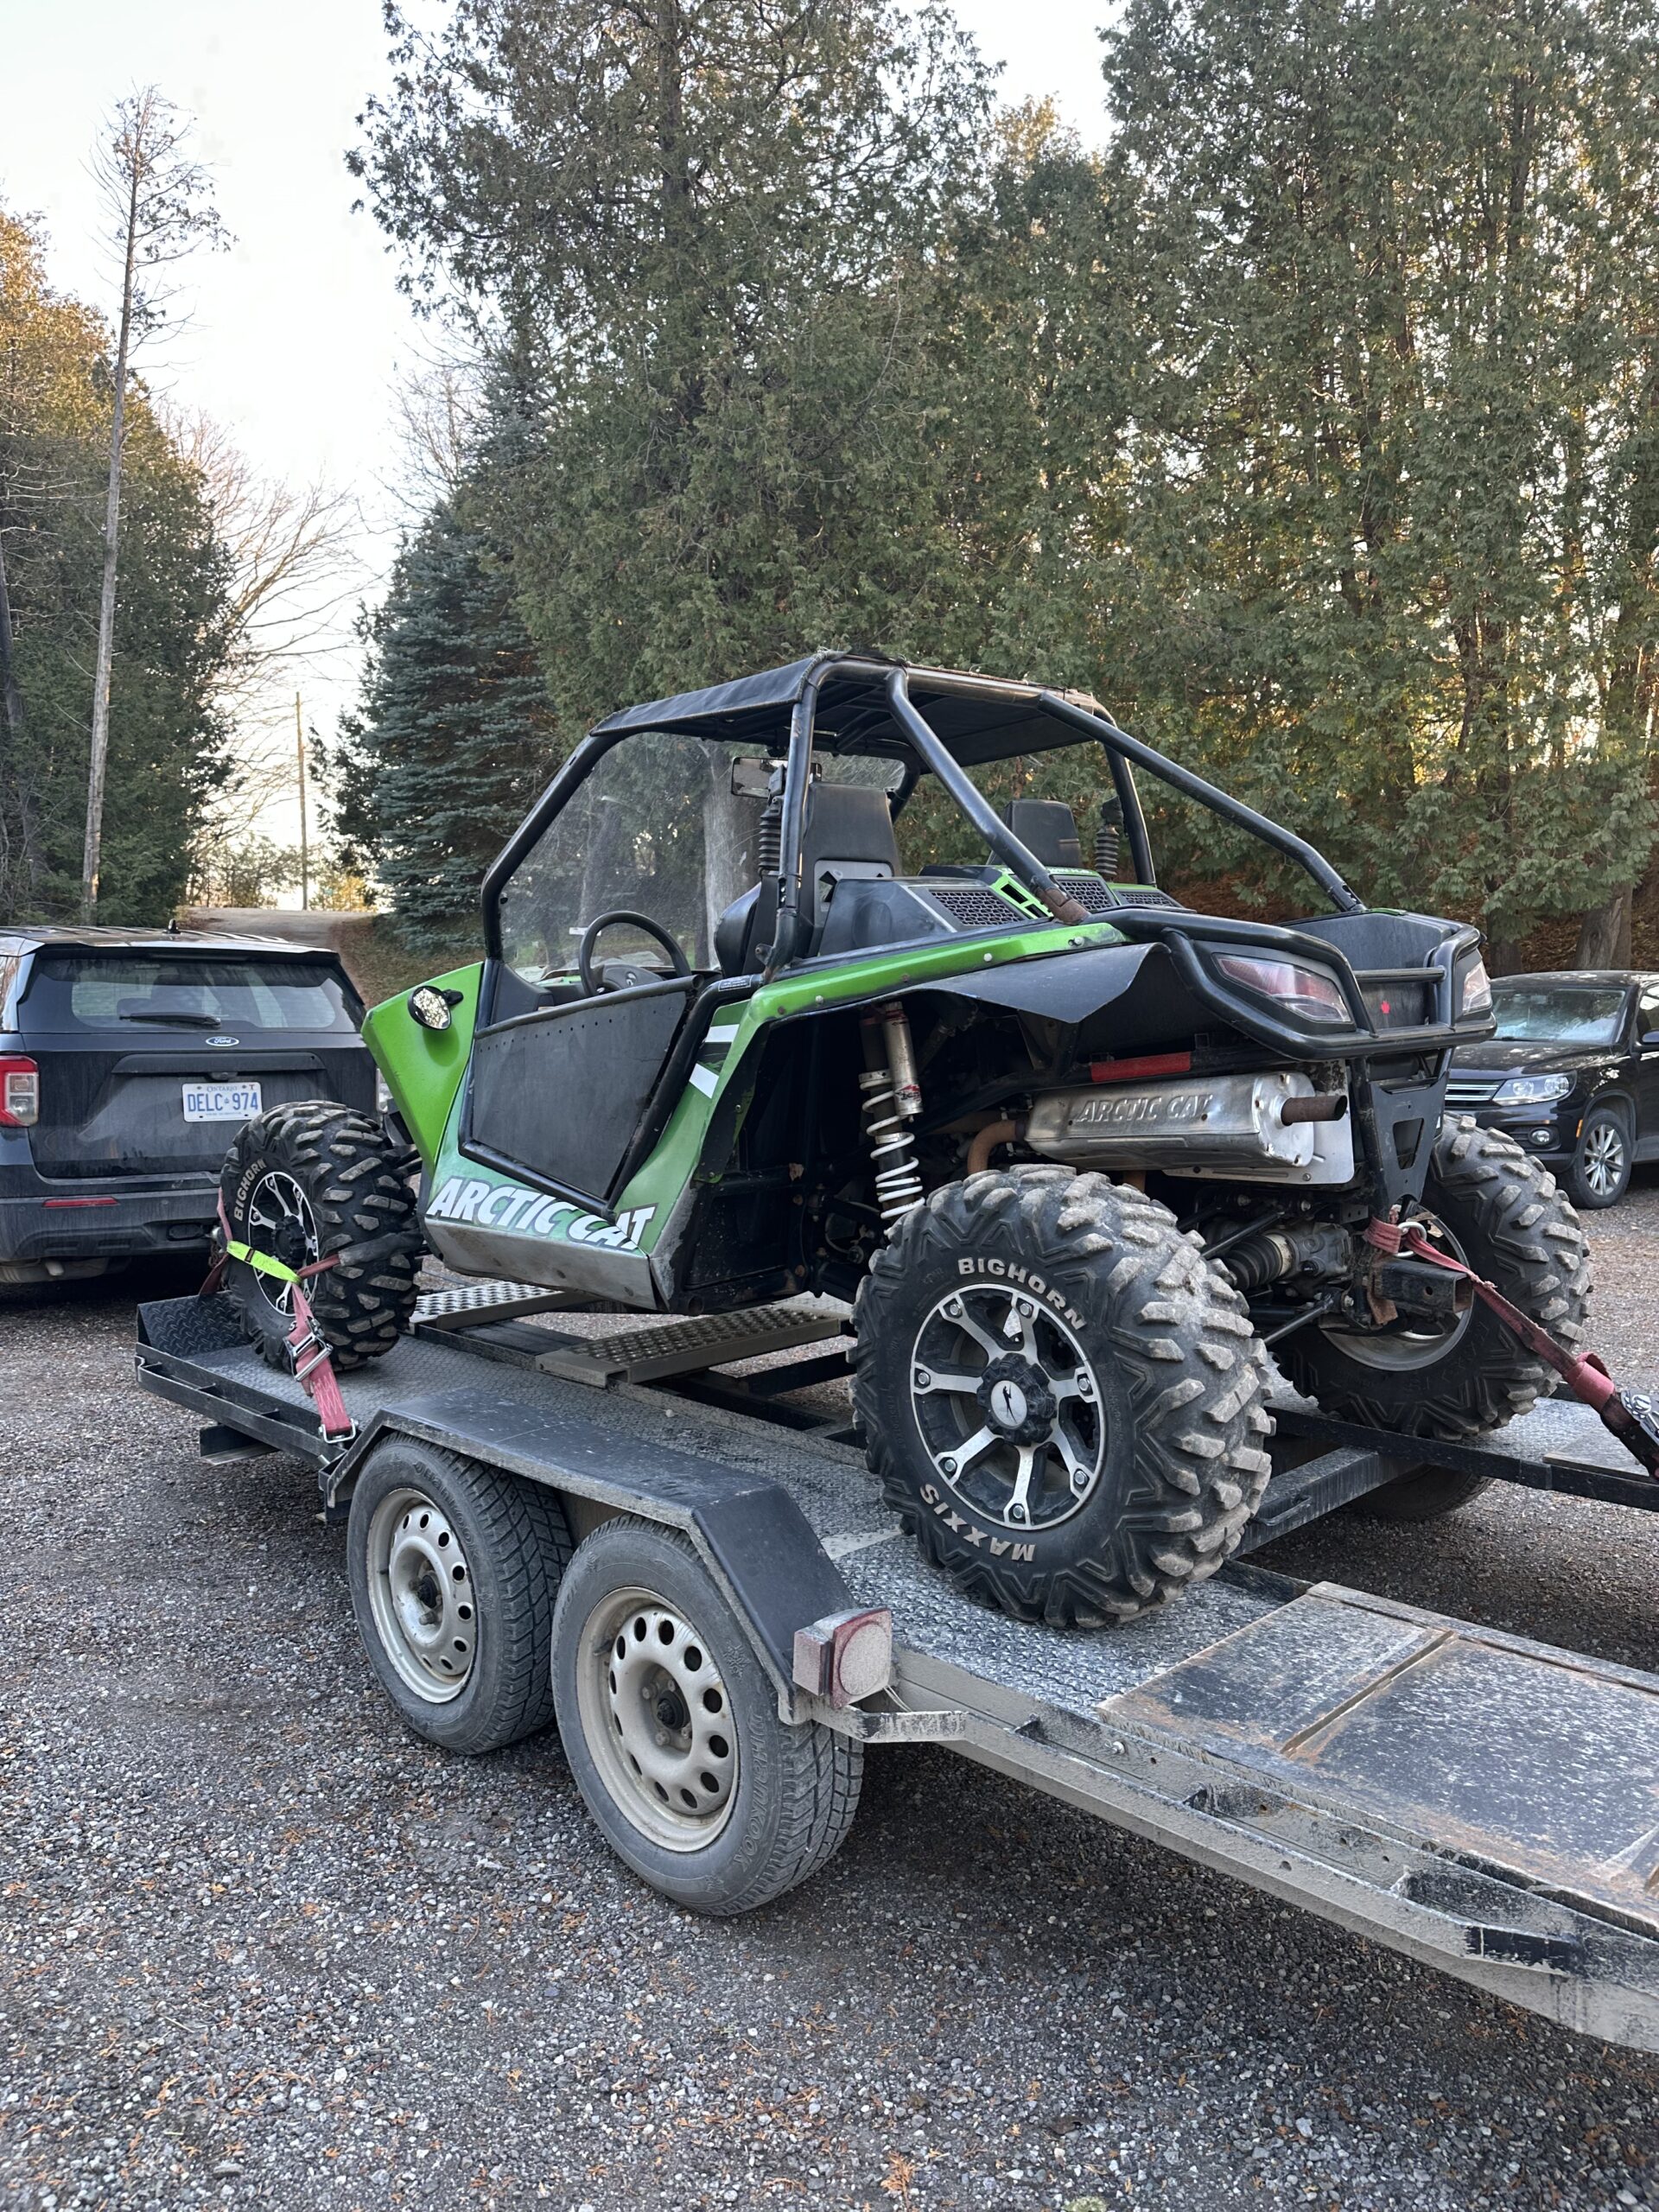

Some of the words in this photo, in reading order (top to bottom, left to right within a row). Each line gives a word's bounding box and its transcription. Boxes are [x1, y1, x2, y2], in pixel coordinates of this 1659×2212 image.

[188, 1093, 223, 1112] DELC
[232, 1092, 258, 1110] 974
[1075, 1096, 1162, 1122] ARCTIC
[1167, 1094, 1213, 1119] CAT
[234, 1159, 267, 1221] BIGHORN
[425, 1176, 580, 1235] ARCTIC
[568, 1206, 656, 1250] CAT
[958, 1257, 1087, 1330] BIGHORN
[919, 1484, 1036, 1561] MAXXIS
